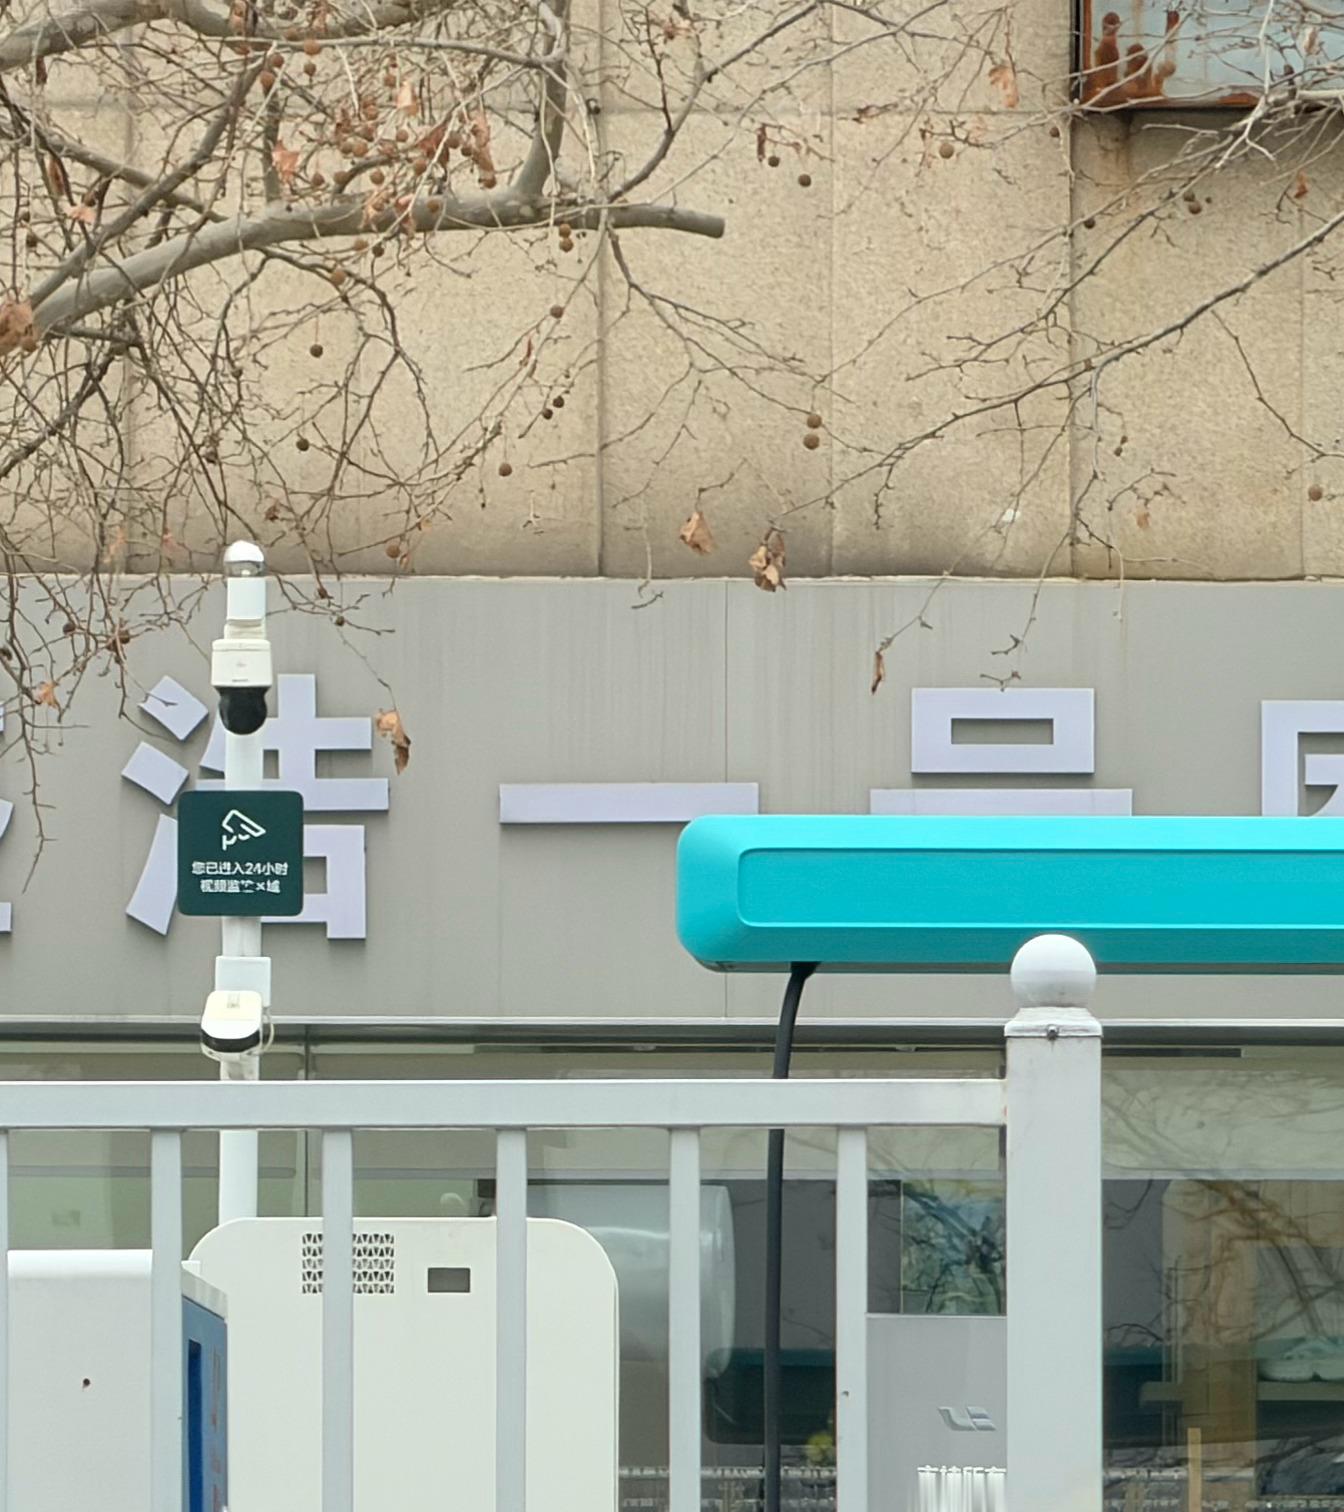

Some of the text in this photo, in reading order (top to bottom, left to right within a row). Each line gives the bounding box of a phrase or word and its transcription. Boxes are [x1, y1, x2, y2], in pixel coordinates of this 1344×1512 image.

[192, 861, 288, 876] 您已进入24小时
